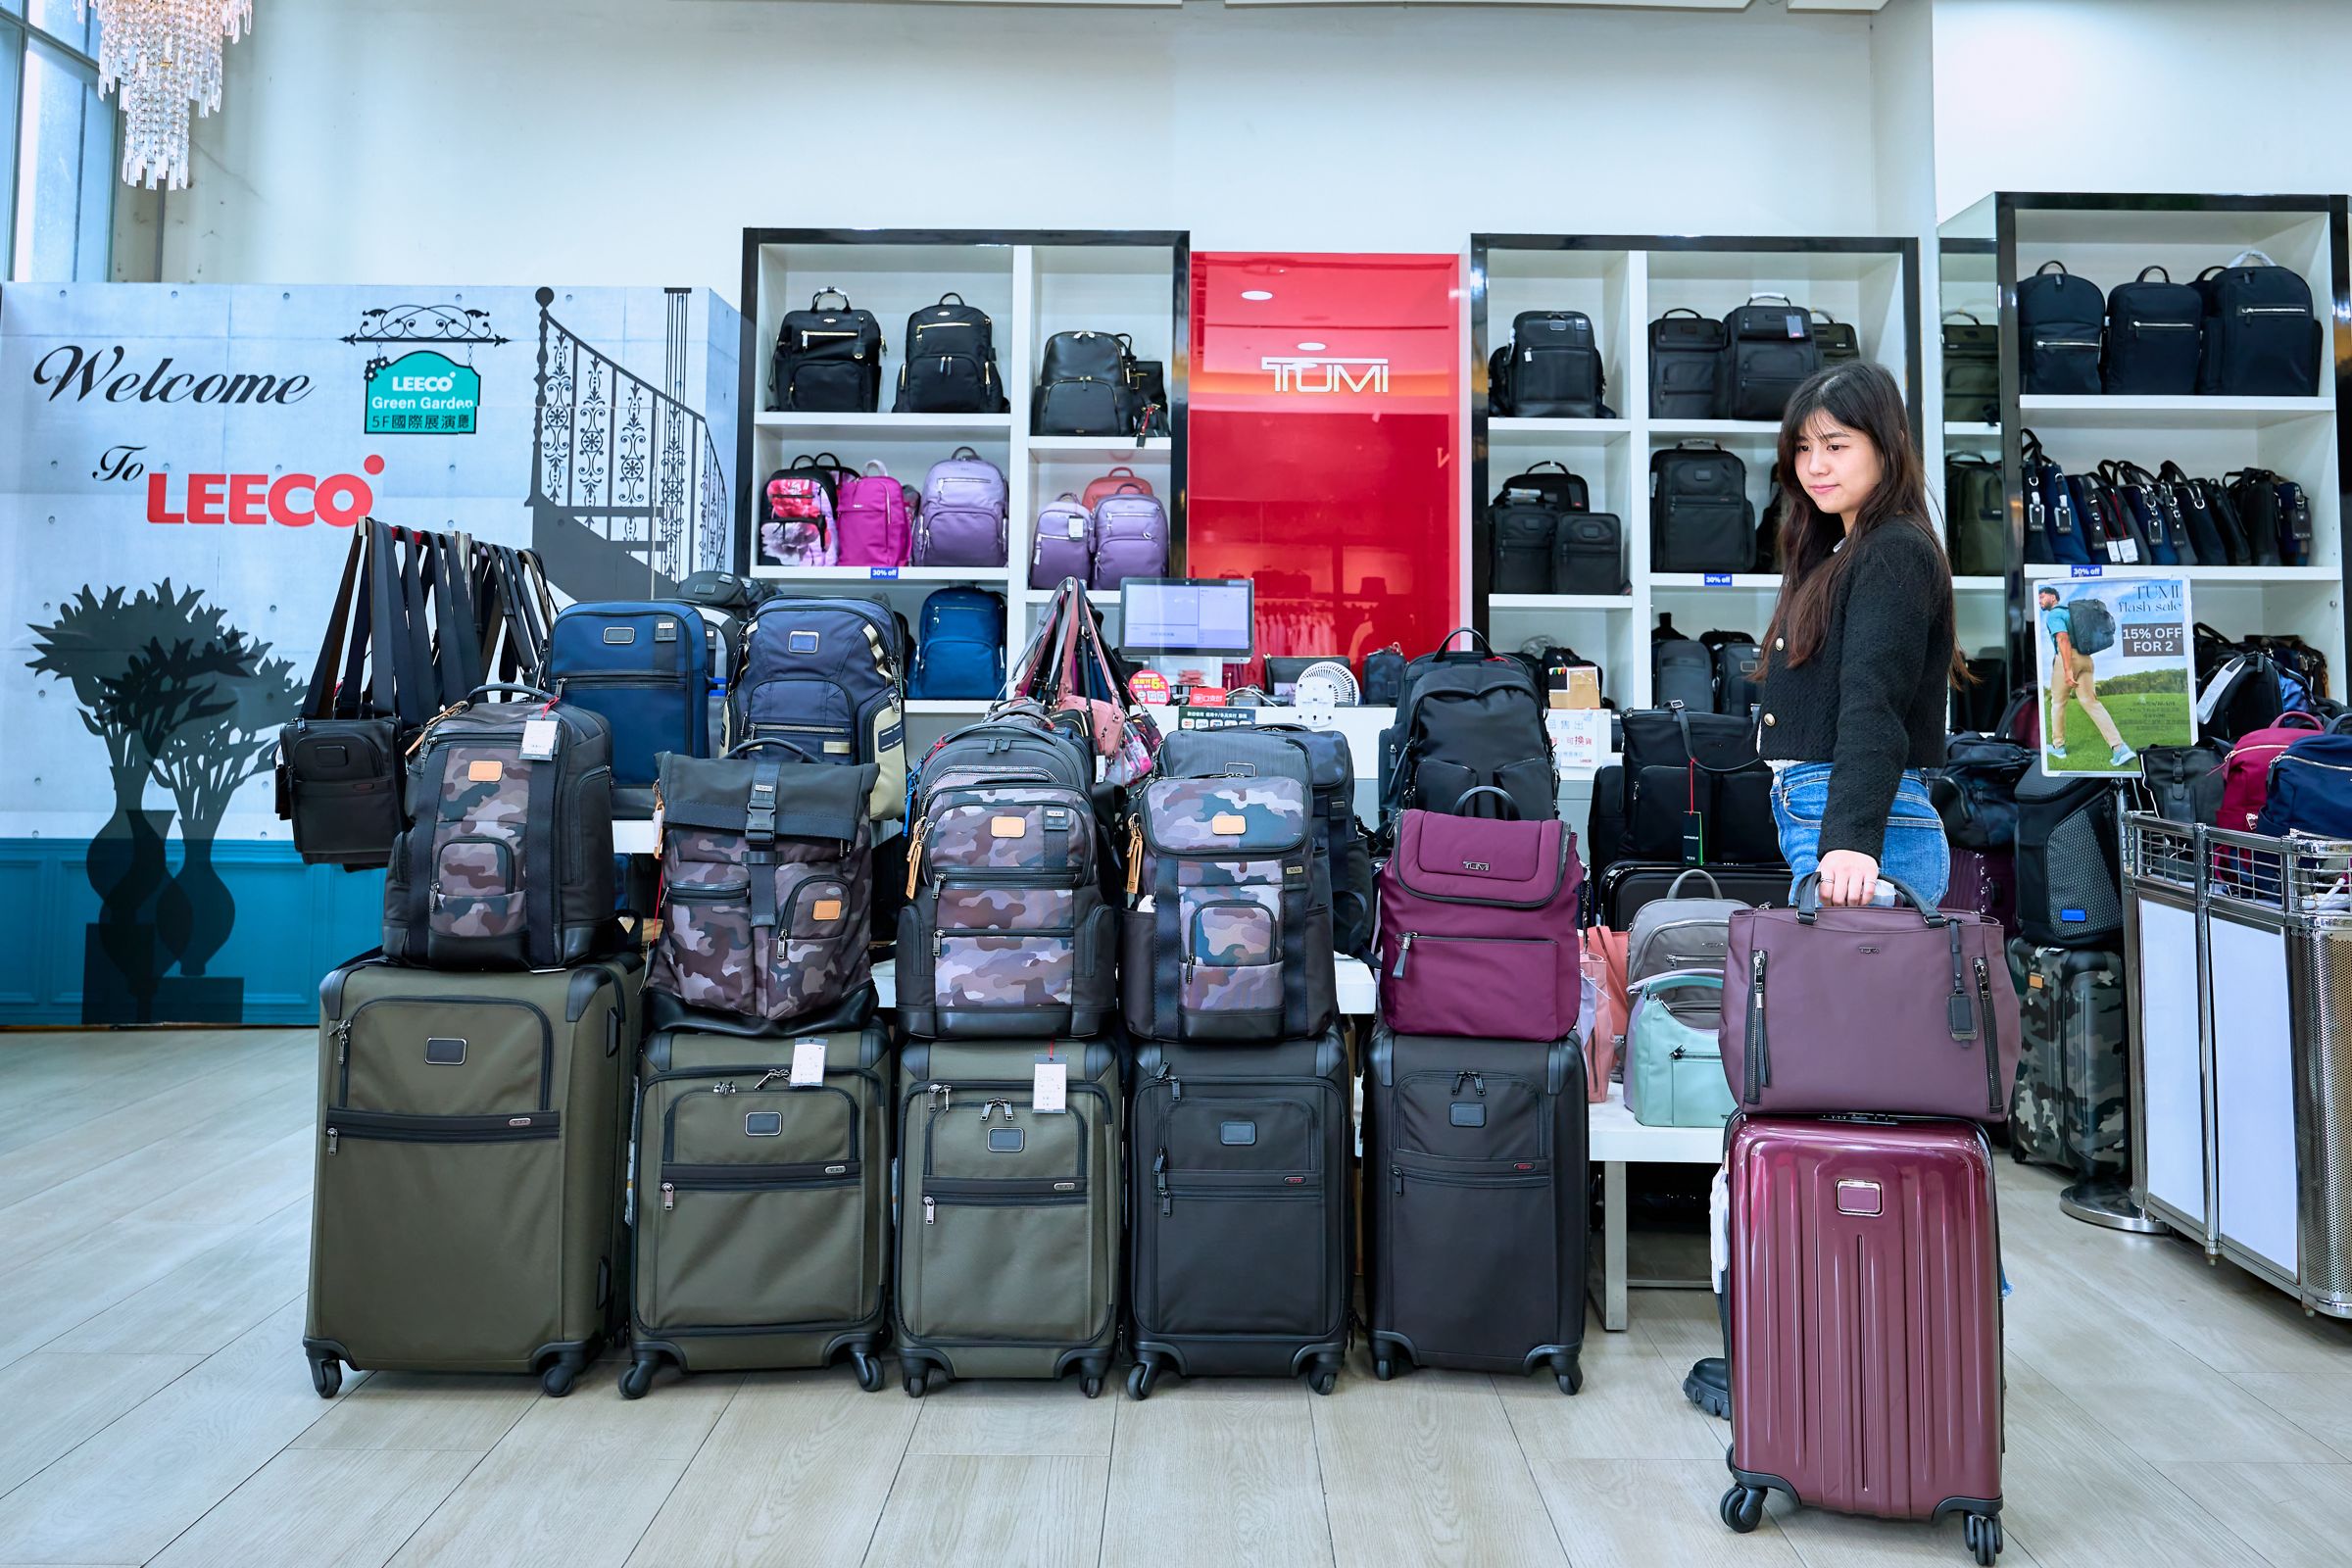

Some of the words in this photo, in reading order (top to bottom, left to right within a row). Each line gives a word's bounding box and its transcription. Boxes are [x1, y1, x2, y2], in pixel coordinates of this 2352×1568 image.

[33, 345, 318, 405] Welcome
[392, 372, 456, 392] LEECO
[1261, 357, 1389, 393] TUMI
[371, 396, 416, 410] Green
[419, 396, 473, 410] Garden
[92, 445, 147, 481] To
[147, 470, 377, 527] LEECO
[2132, 584, 2180, 600] TUMI
[2118, 601, 2151, 612] flash
[2155, 601, 2182, 612] sale
[2123, 628, 2151, 640] 15%
[2154, 627, 2182, 639] OFF
[2133, 641, 2162, 653] FOR
[2165, 640, 2174, 652] 2
[1463, 860, 1490, 871] TUMI
